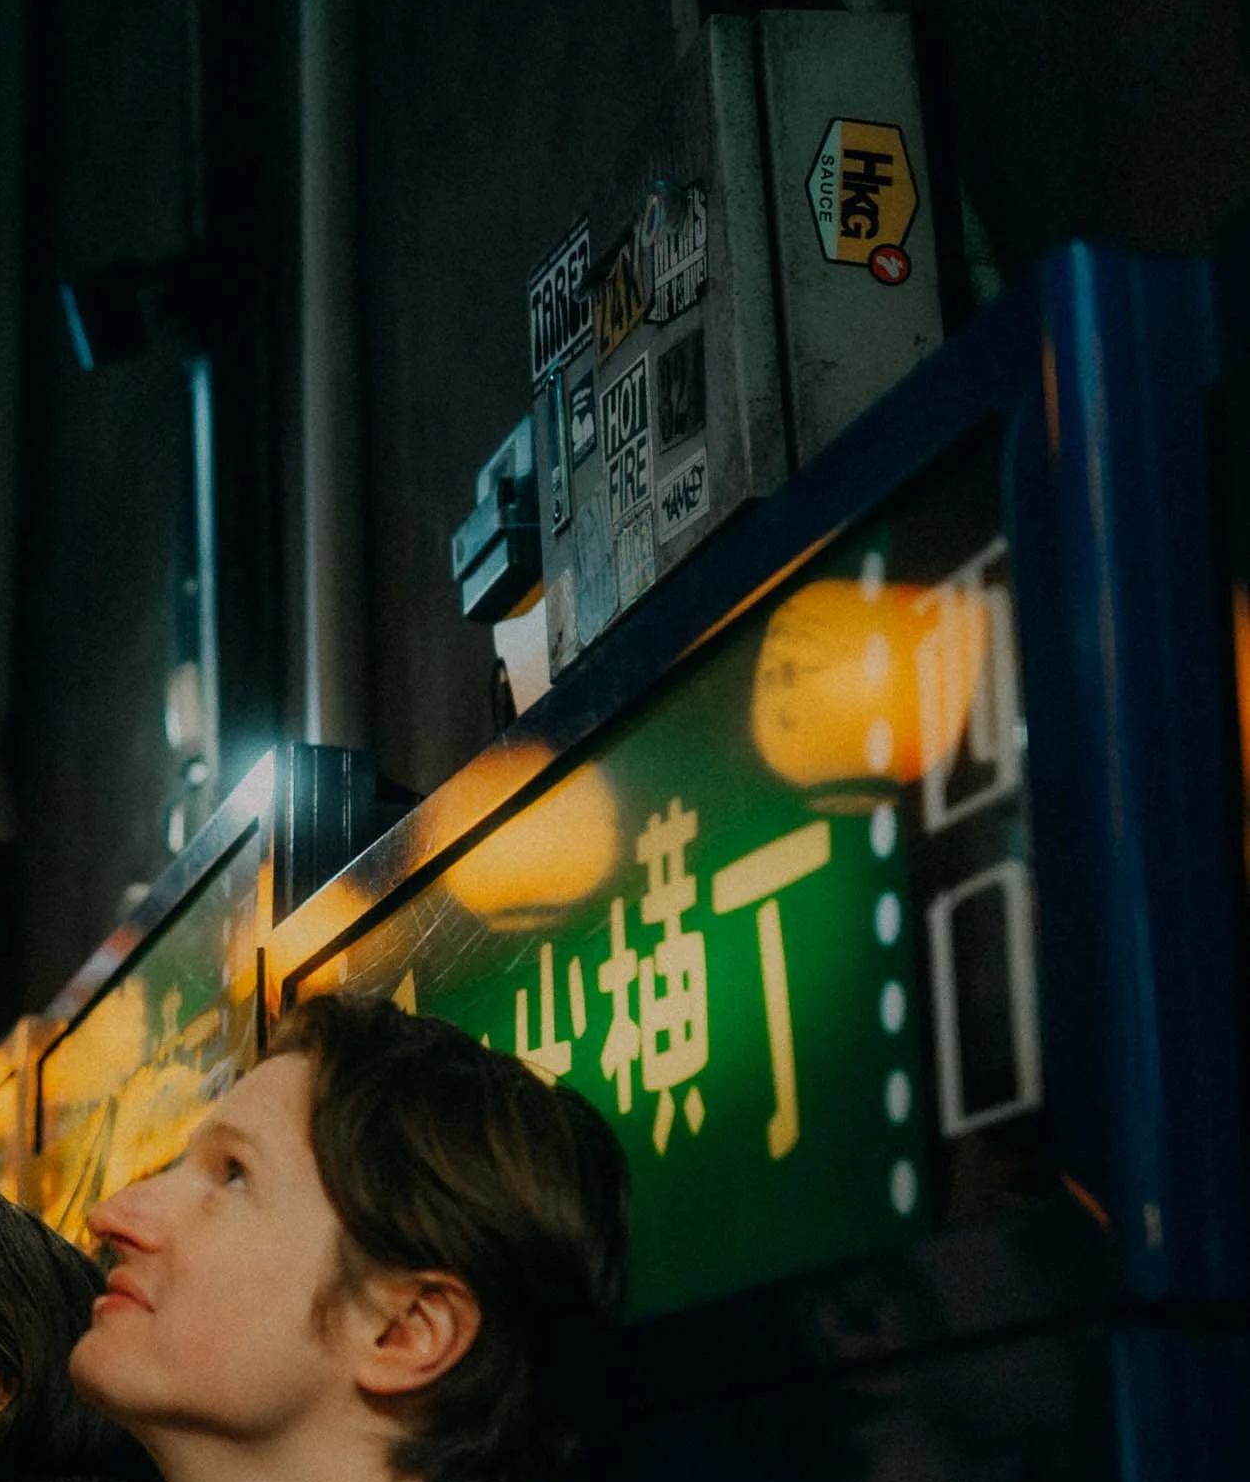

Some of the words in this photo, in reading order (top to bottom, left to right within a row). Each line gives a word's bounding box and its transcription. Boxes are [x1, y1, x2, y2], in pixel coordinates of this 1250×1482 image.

[819, 154, 835, 223] SAUCE
[607, 362, 646, 457] HOT
[609, 434, 646, 517] FIRE
